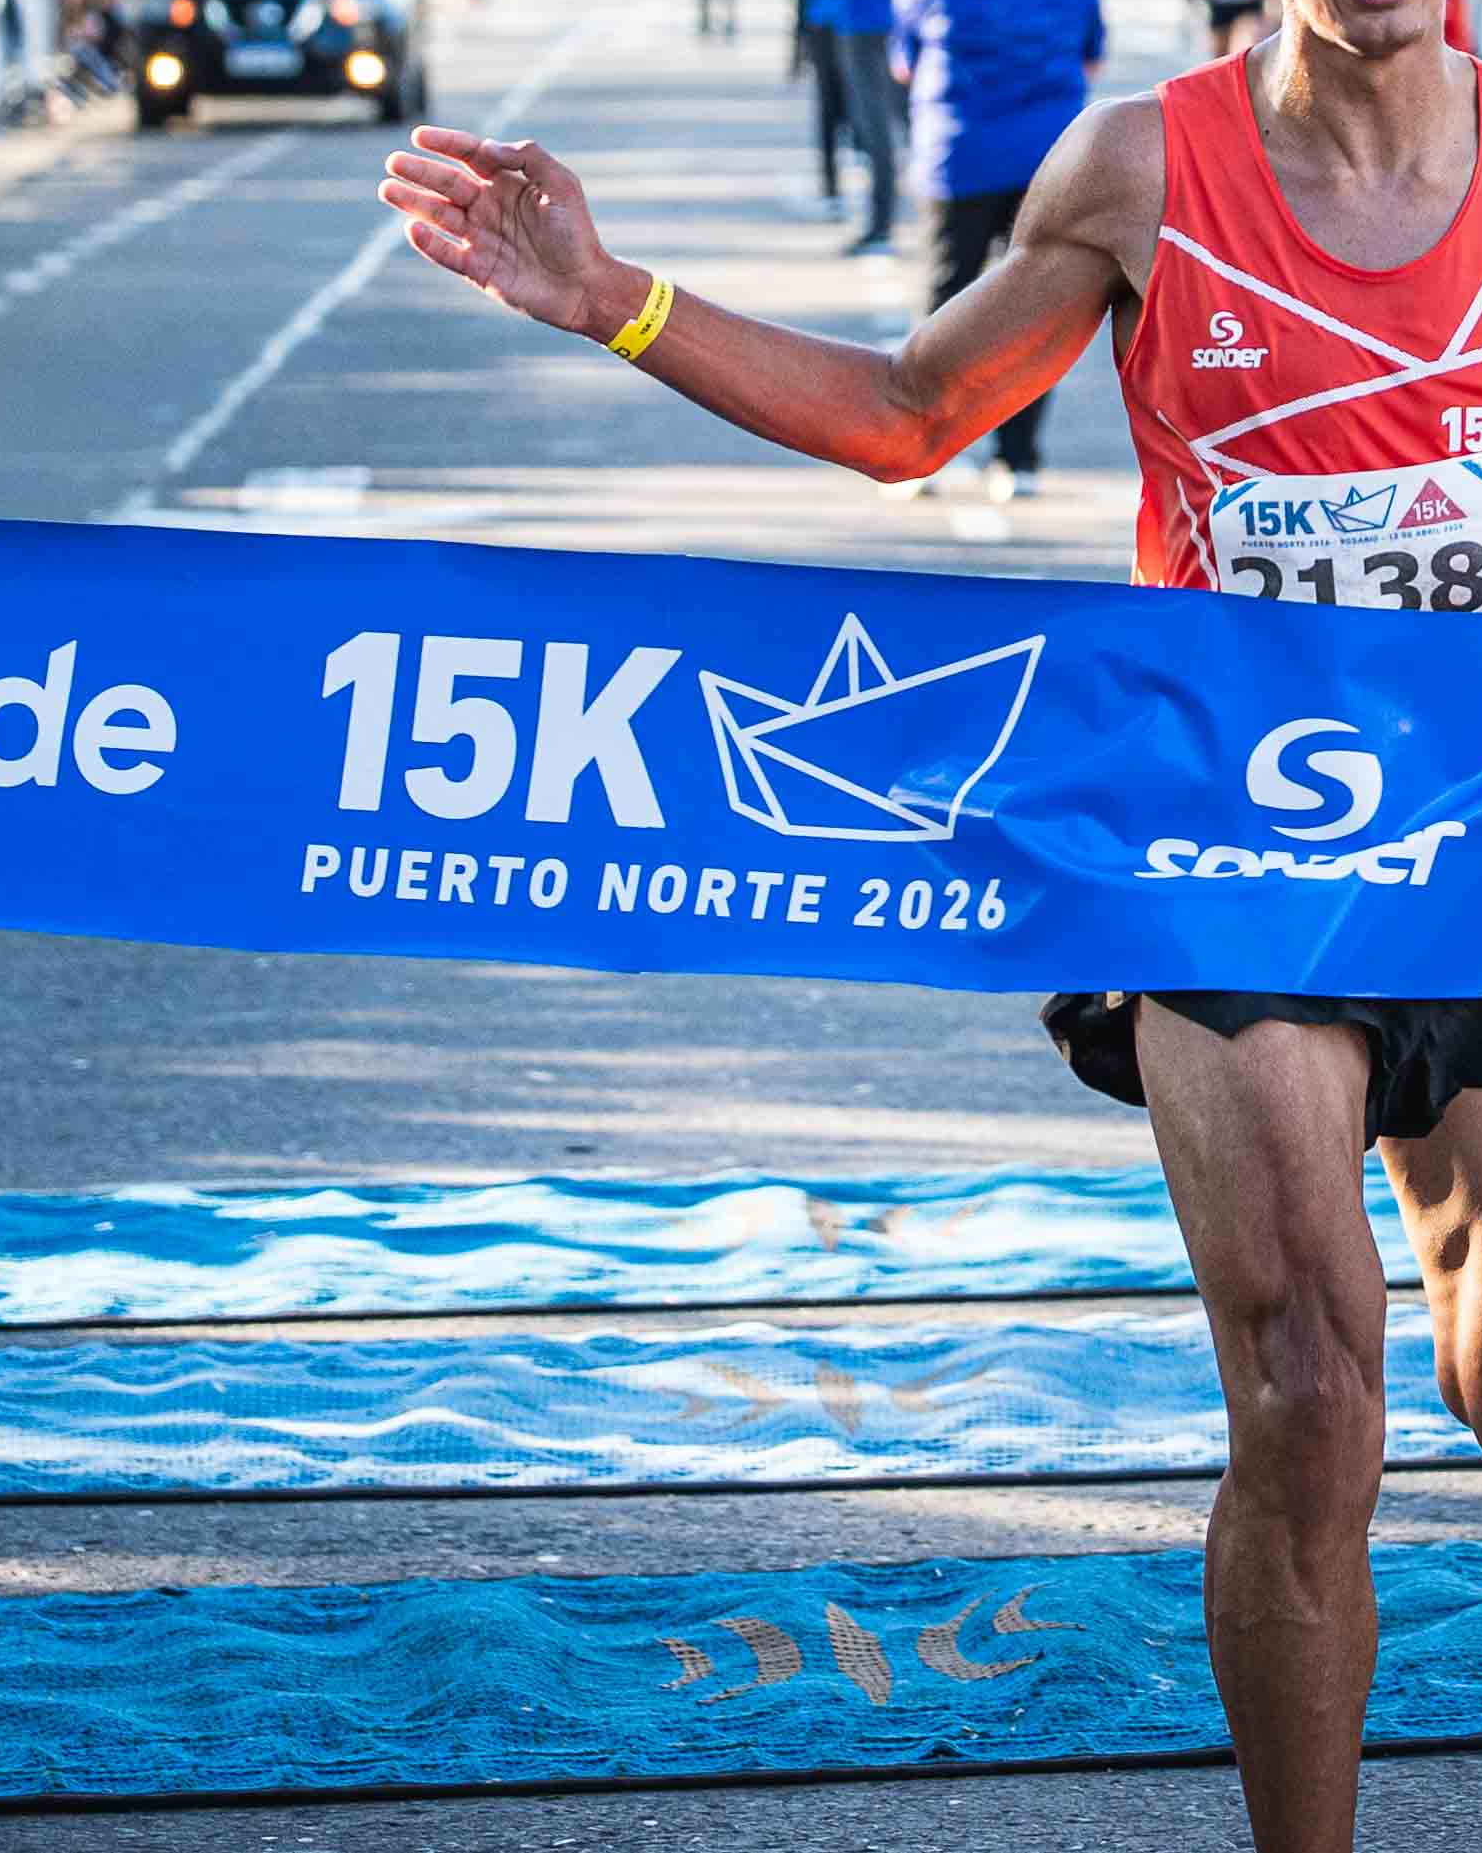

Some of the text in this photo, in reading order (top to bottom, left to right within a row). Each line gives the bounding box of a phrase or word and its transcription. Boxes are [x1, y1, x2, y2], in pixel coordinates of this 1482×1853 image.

[1239, 499, 1316, 536] 15K
[1413, 499, 1450, 521] 15K
[321, 632, 683, 829] 15K
[301, 843, 1009, 933] PUERTO NORTE 2026
